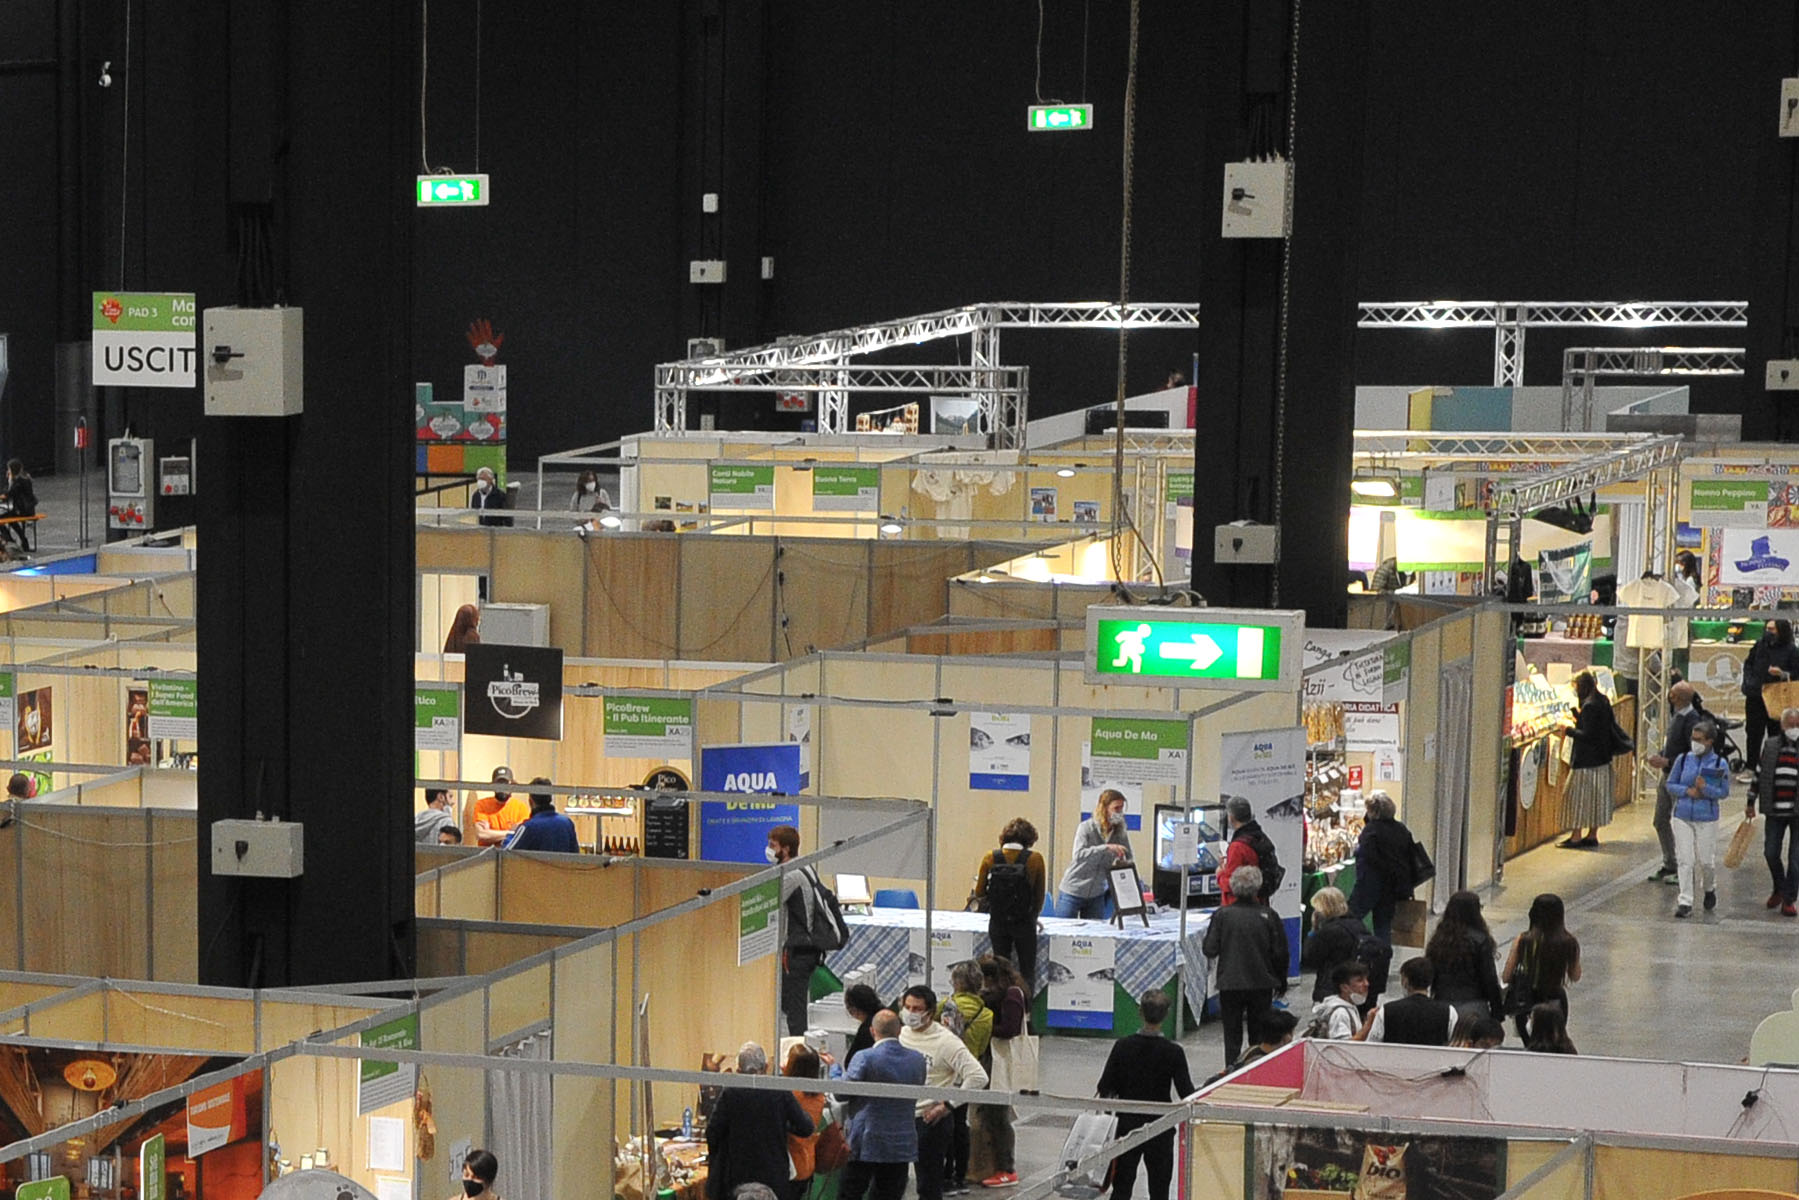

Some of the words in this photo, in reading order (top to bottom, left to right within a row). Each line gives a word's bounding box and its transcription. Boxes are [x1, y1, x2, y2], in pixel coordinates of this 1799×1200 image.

[128, 307, 149, 318] PAD
[151, 307, 158, 318] 3
[105, 345, 196, 373] USCIT
[606, 702, 650, 713] PicoBrew
[621, 715, 639, 724] Pub
[640, 714, 689, 725] Itinerante
[1094, 728, 1122, 742] Aqua
[1124, 730, 1139, 741] De
[1253, 742, 1273, 752] AQUA
[724, 772, 778, 794] AQUA
[1366, 1161, 1401, 1180] bio
